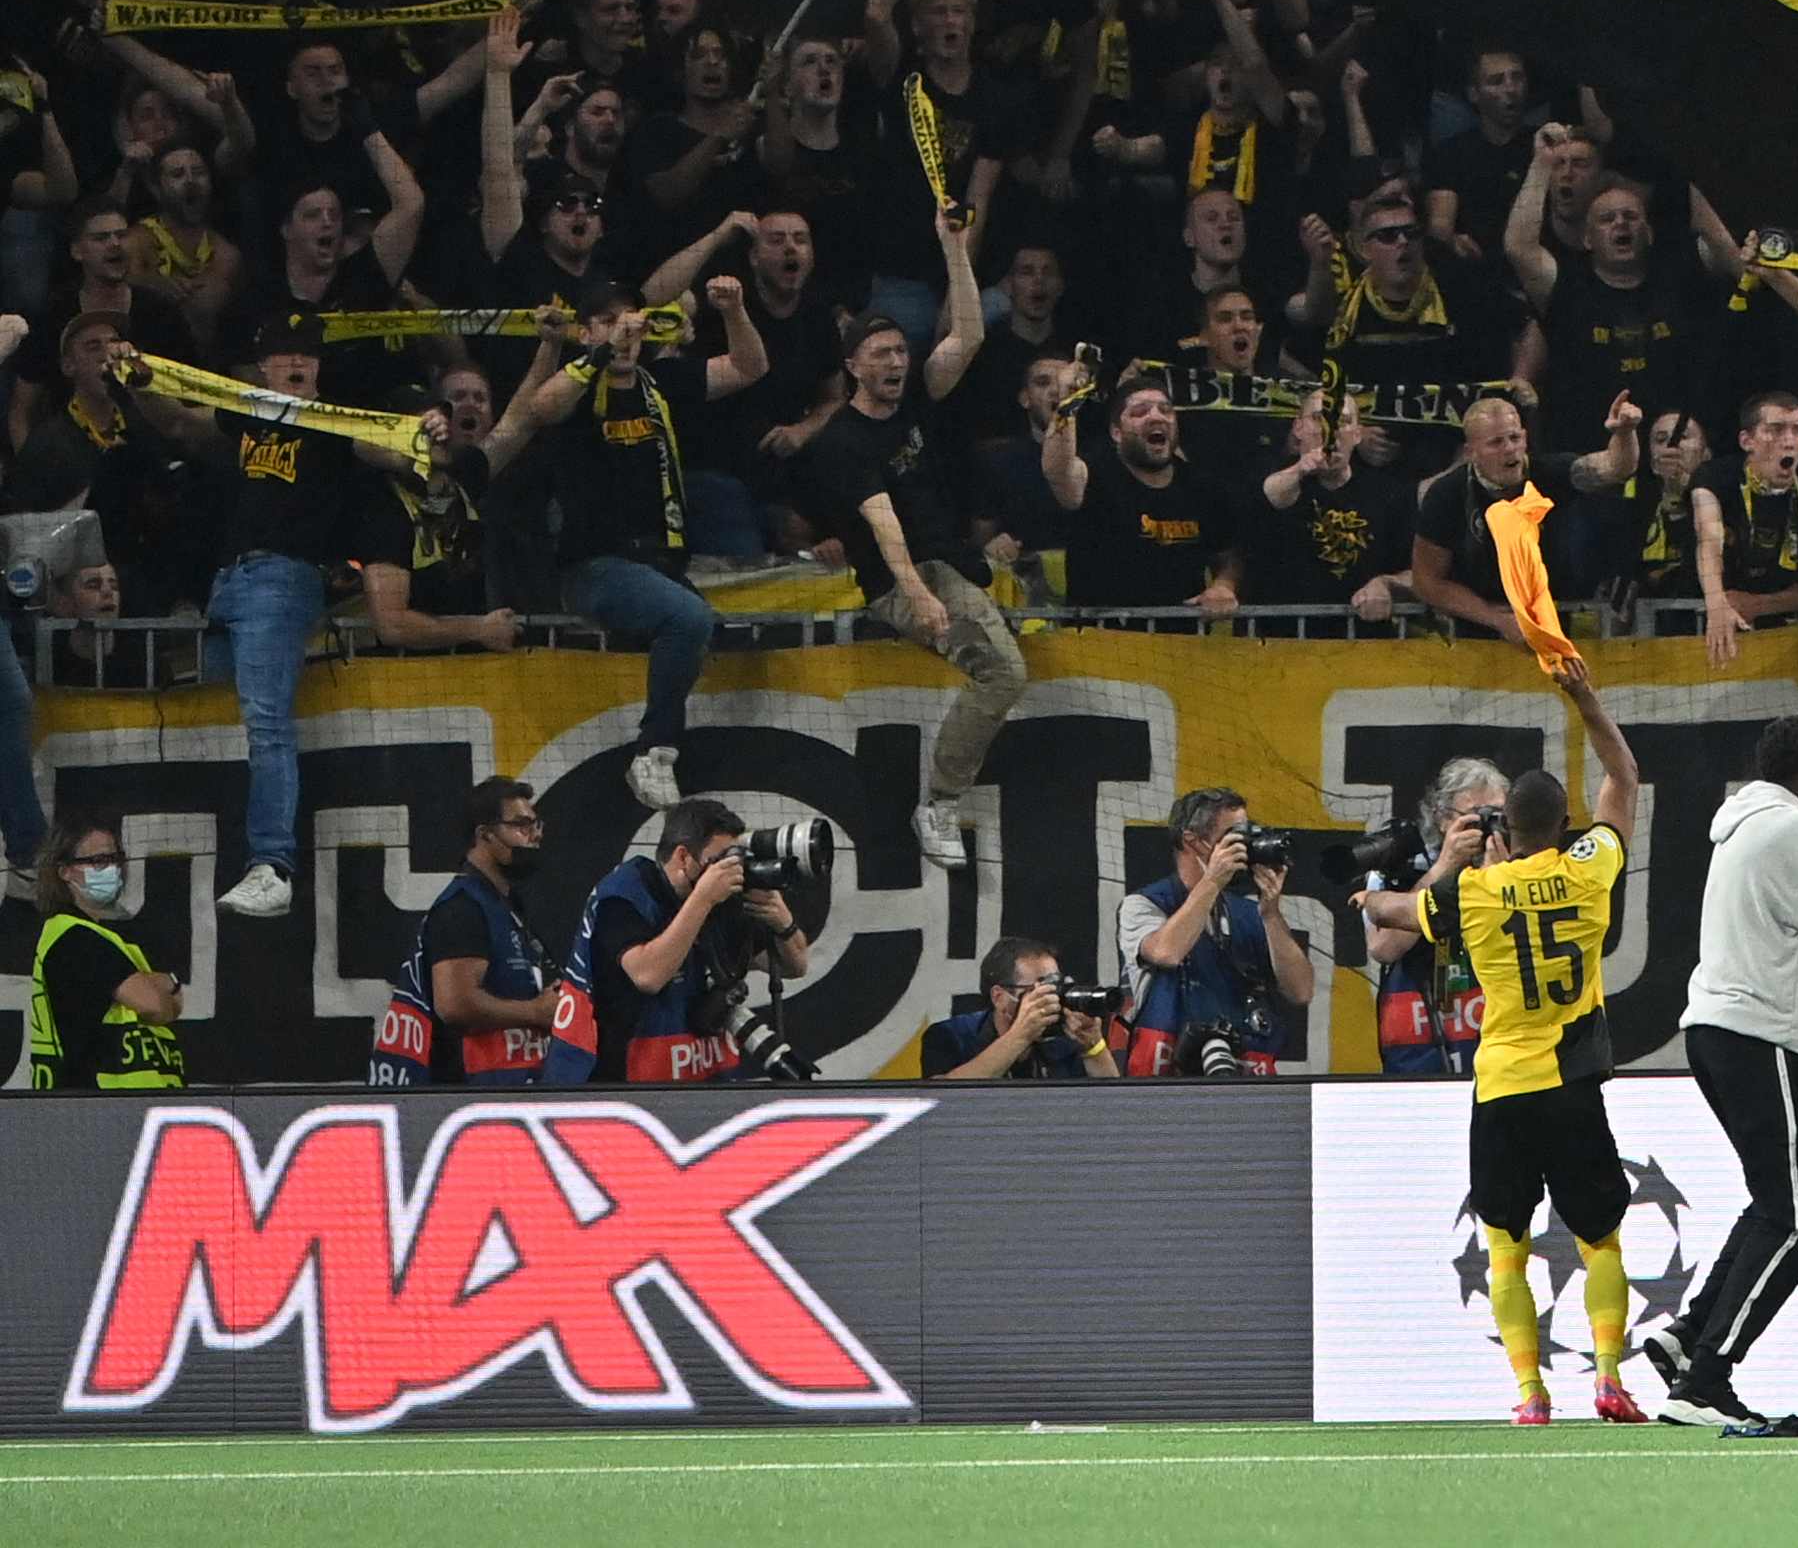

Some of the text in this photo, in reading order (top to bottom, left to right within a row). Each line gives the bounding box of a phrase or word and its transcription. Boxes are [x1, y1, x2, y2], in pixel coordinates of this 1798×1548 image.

[1502, 876, 1568, 909] M. ELIA
[1501, 906, 1583, 1010] 15
[63, 1098, 938, 1433] MAX
